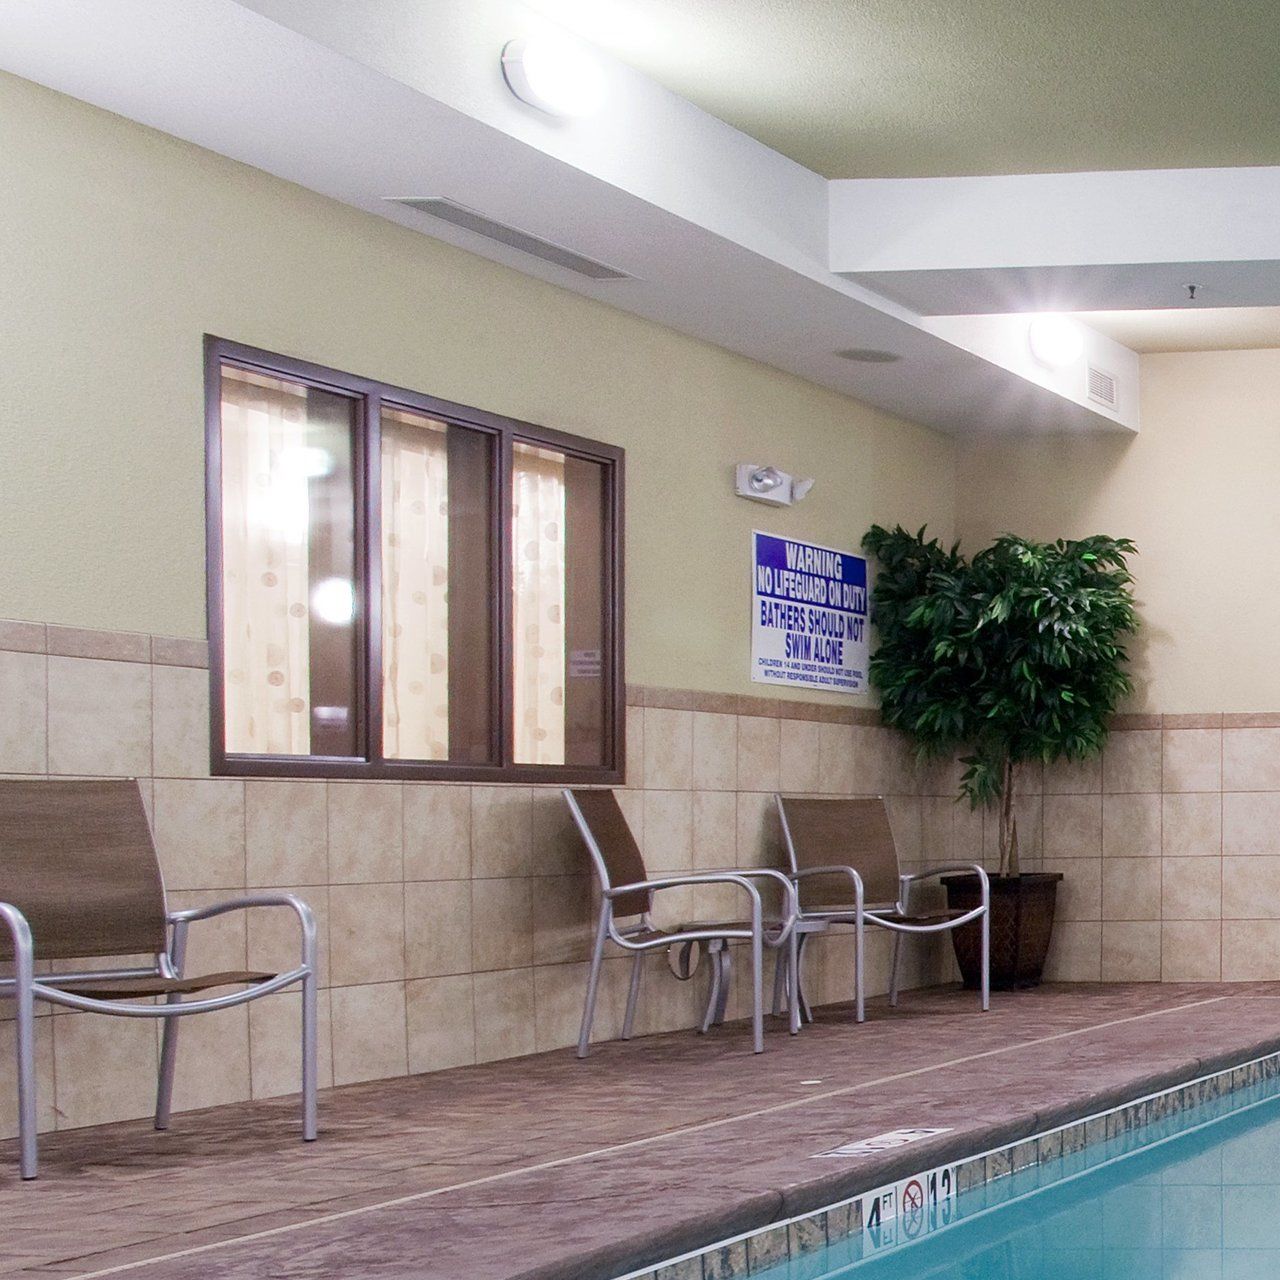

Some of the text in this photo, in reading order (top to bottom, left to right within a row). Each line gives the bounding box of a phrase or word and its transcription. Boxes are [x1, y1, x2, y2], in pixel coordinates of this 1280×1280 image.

[785, 542, 842, 579] WARNING
[758, 565, 866, 612] NO LIFEGUARD ON DUTY
[761, 600, 864, 643] BATHERS SHOULD NOT
[759, 658, 782, 667] CHILDREN
[791, 662, 800, 670] AND
[802, 664, 817, 672] UNDER
[818, 666, 834, 674] SHOULD
[785, 632, 843, 666] SWIM ALONE
[764, 669, 786, 678] WITHOUT
[787, 672, 818, 683] RESPONSIBLE
[883, 1192, 893, 1210] FT
